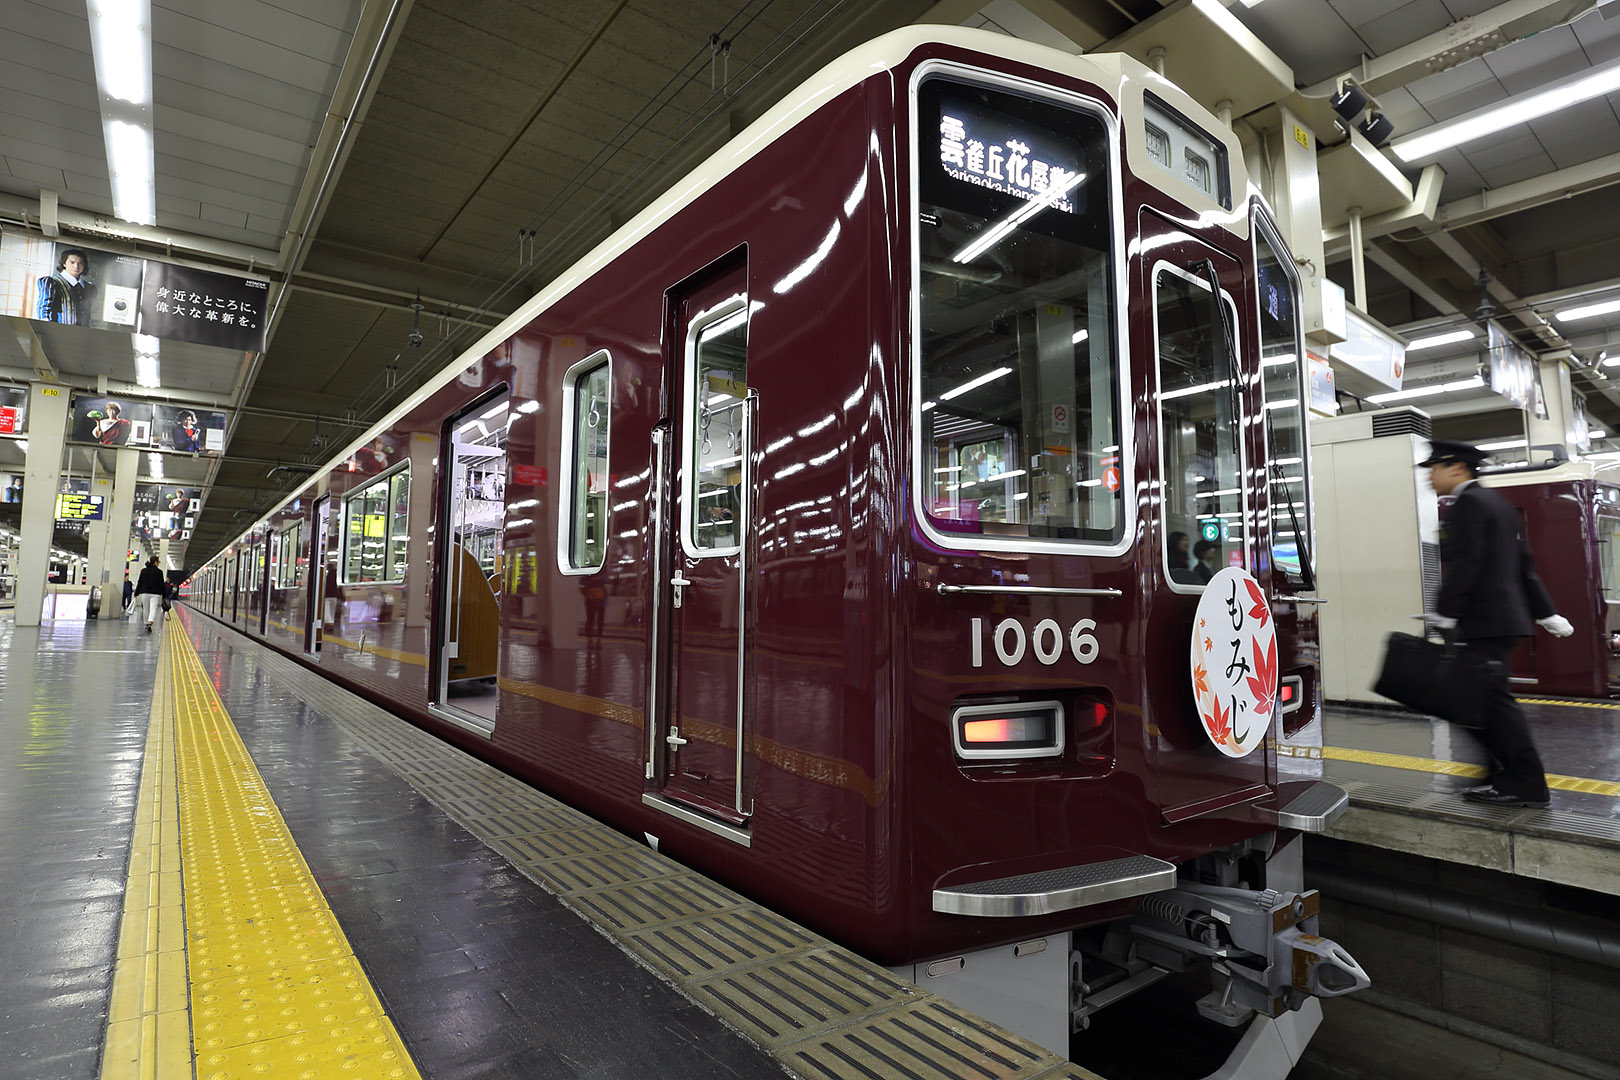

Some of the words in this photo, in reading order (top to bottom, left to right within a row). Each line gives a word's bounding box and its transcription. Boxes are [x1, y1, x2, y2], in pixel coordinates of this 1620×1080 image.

[155, 300, 256, 329] 偉大な革新を。
[156, 286, 257, 315] 身近なところに、
[971, 617, 1100, 668] 1006
[1225, 578, 1251, 745] もみじ
